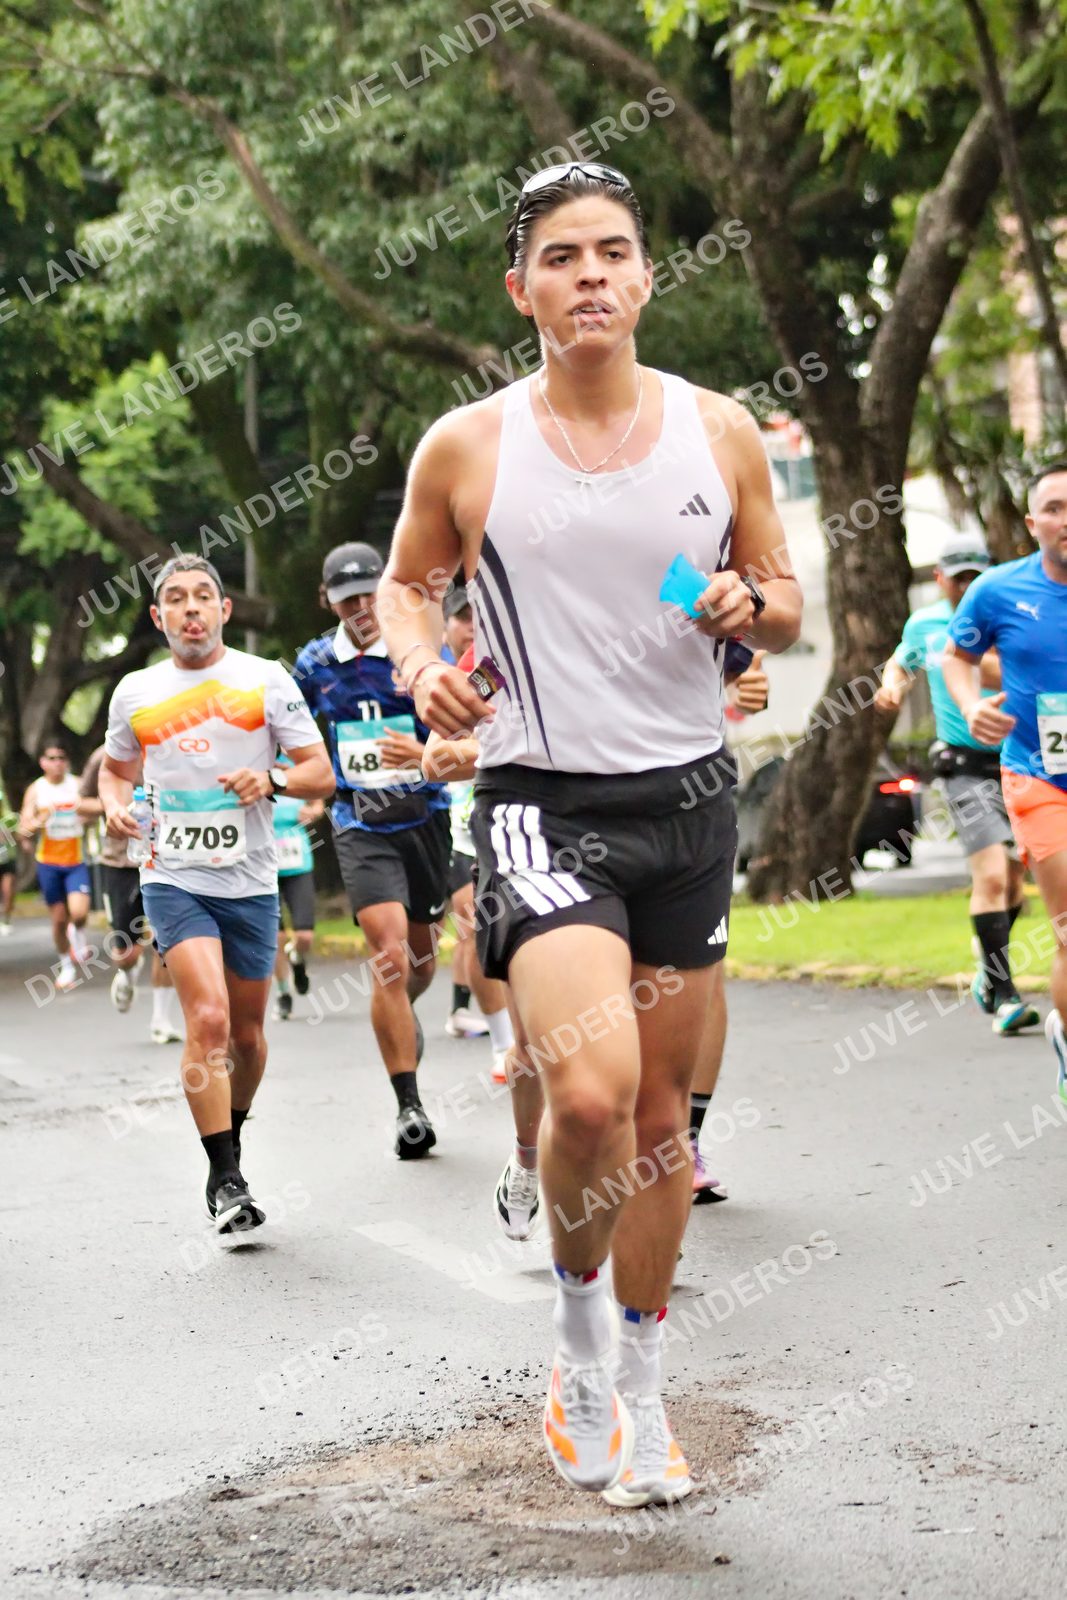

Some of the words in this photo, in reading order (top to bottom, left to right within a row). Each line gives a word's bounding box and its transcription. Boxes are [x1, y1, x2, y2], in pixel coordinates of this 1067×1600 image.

[357, 700, 383, 723] 11
[1046, 731, 1067, 754] 2
[348, 753, 379, 773] 48
[166, 824, 239, 850] 4709
